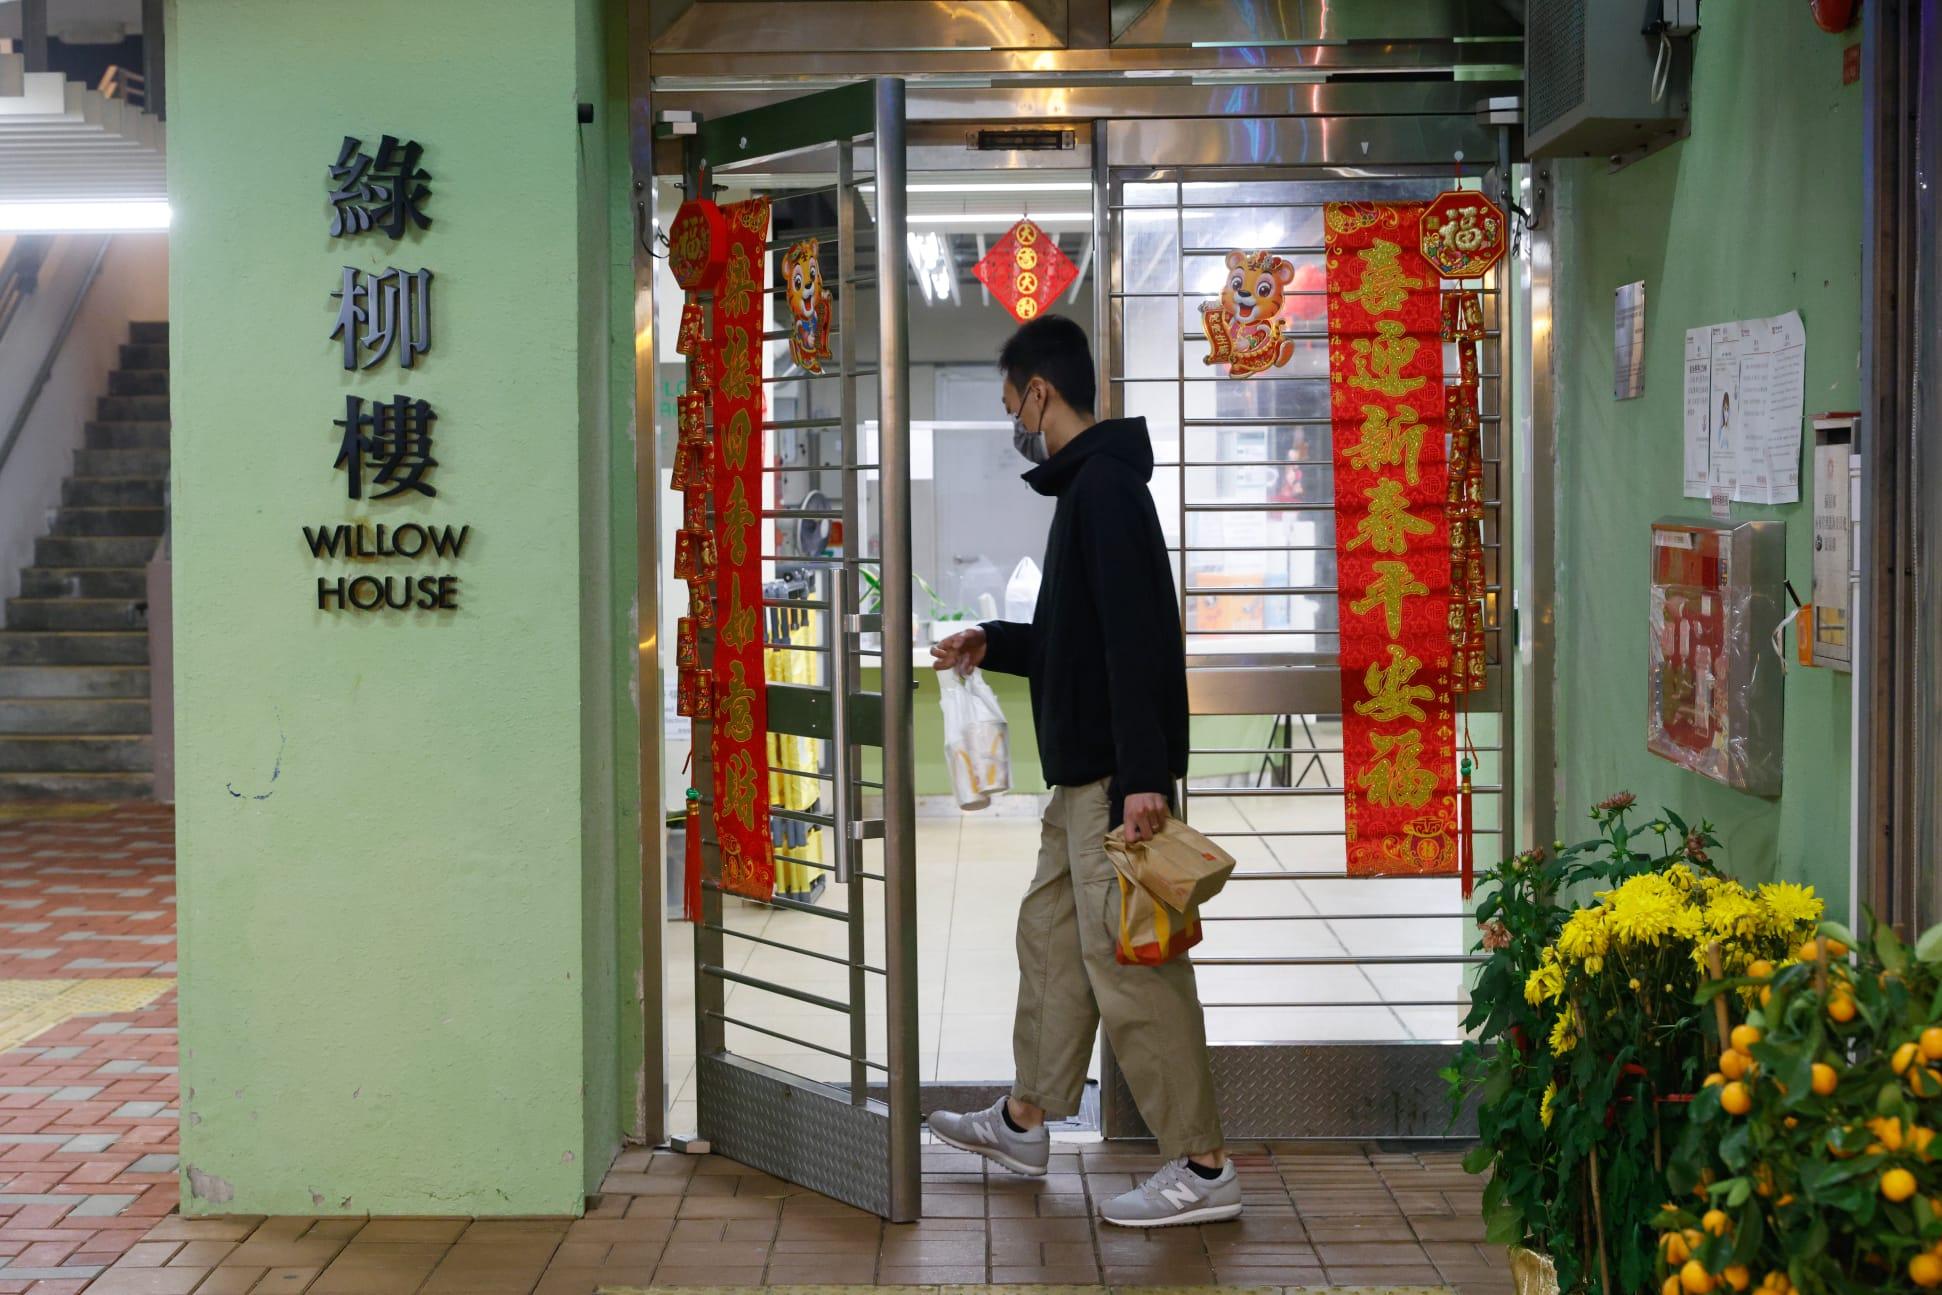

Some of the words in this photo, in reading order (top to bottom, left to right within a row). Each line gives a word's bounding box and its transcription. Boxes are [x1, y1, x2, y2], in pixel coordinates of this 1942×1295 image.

[1439, 206, 1483, 251] 福
[328, 135, 438, 500] 綠柳樓
[303, 523, 470, 560] WILLOW
[318, 576, 458, 612] HOUSE
[1160, 1181, 1200, 1211] N
